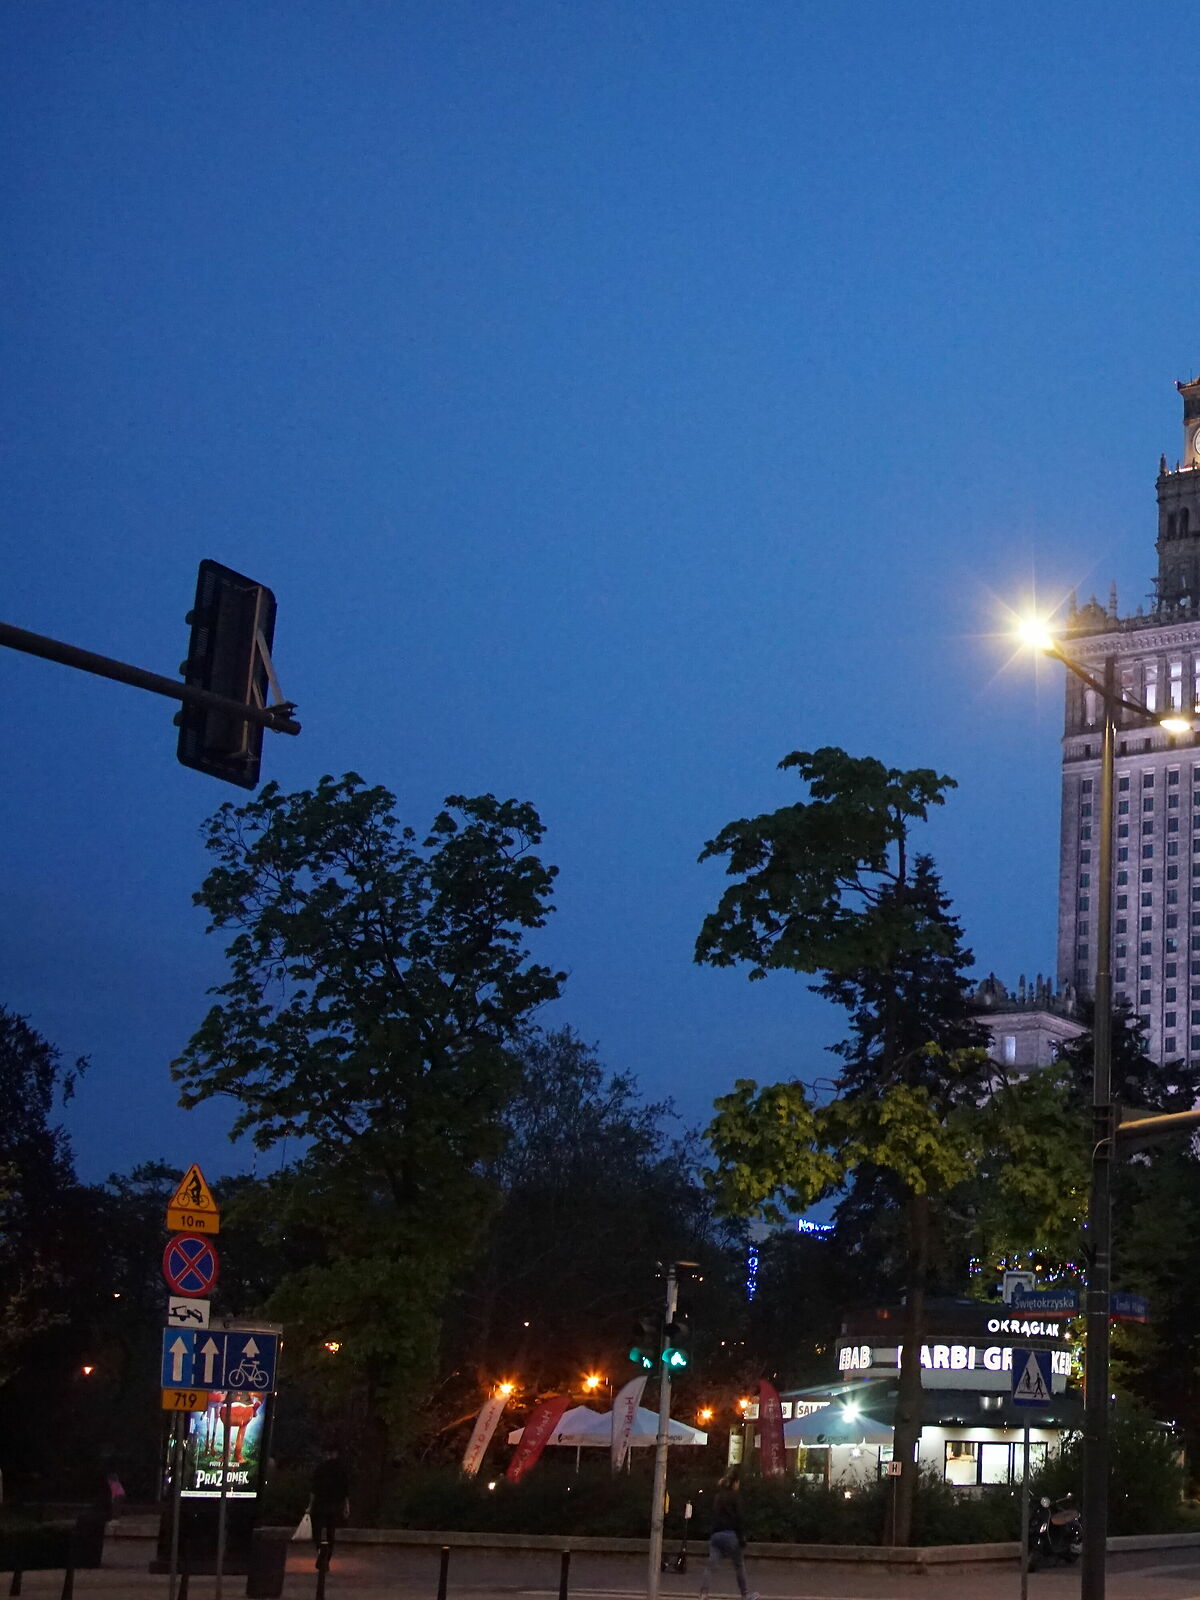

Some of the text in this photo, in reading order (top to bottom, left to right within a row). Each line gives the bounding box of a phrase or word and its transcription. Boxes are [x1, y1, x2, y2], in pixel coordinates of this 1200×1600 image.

[1014, 1296, 1074, 1311] Świętokrzyska
[987, 1318, 1059, 1338] OKRĄGLAK
[838, 1345, 871, 1370] EBAB
[983, 1346, 1013, 1371] GR
[174, 1392, 197, 1408] 719
[195, 1469, 249, 1489] PRAZOMEK
